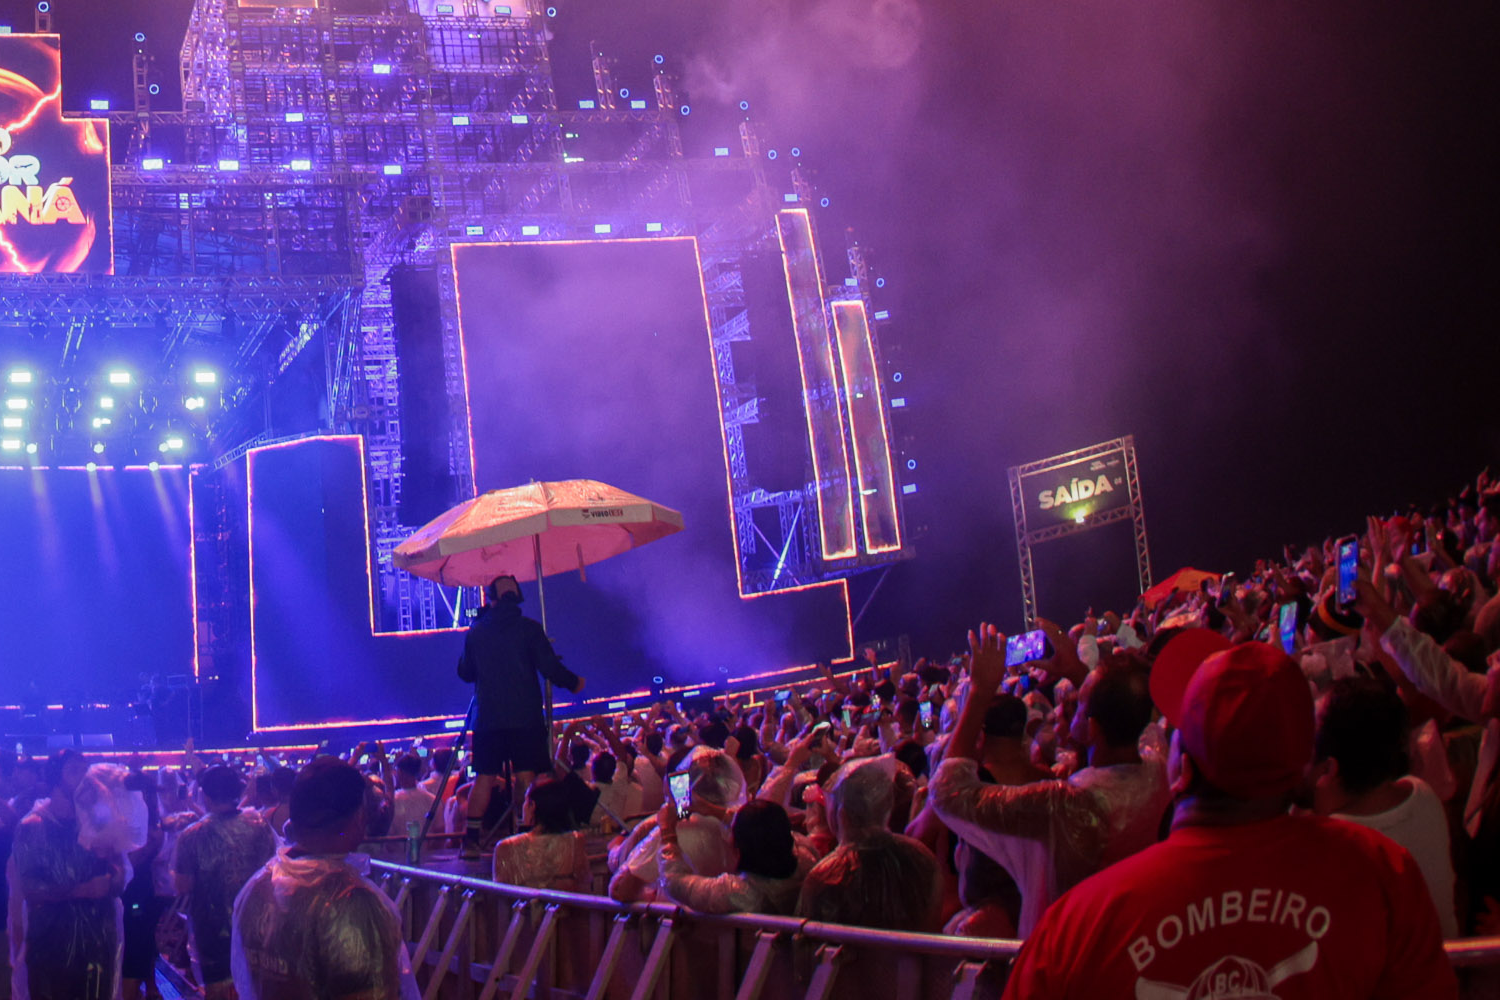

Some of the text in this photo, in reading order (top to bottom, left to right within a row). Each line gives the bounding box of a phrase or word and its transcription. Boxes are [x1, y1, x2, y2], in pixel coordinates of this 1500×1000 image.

[1038, 474, 1114, 510] SAÍDA
[1127, 888, 1331, 971] BOMBEIRO
[1216, 970, 1240, 993] BC
